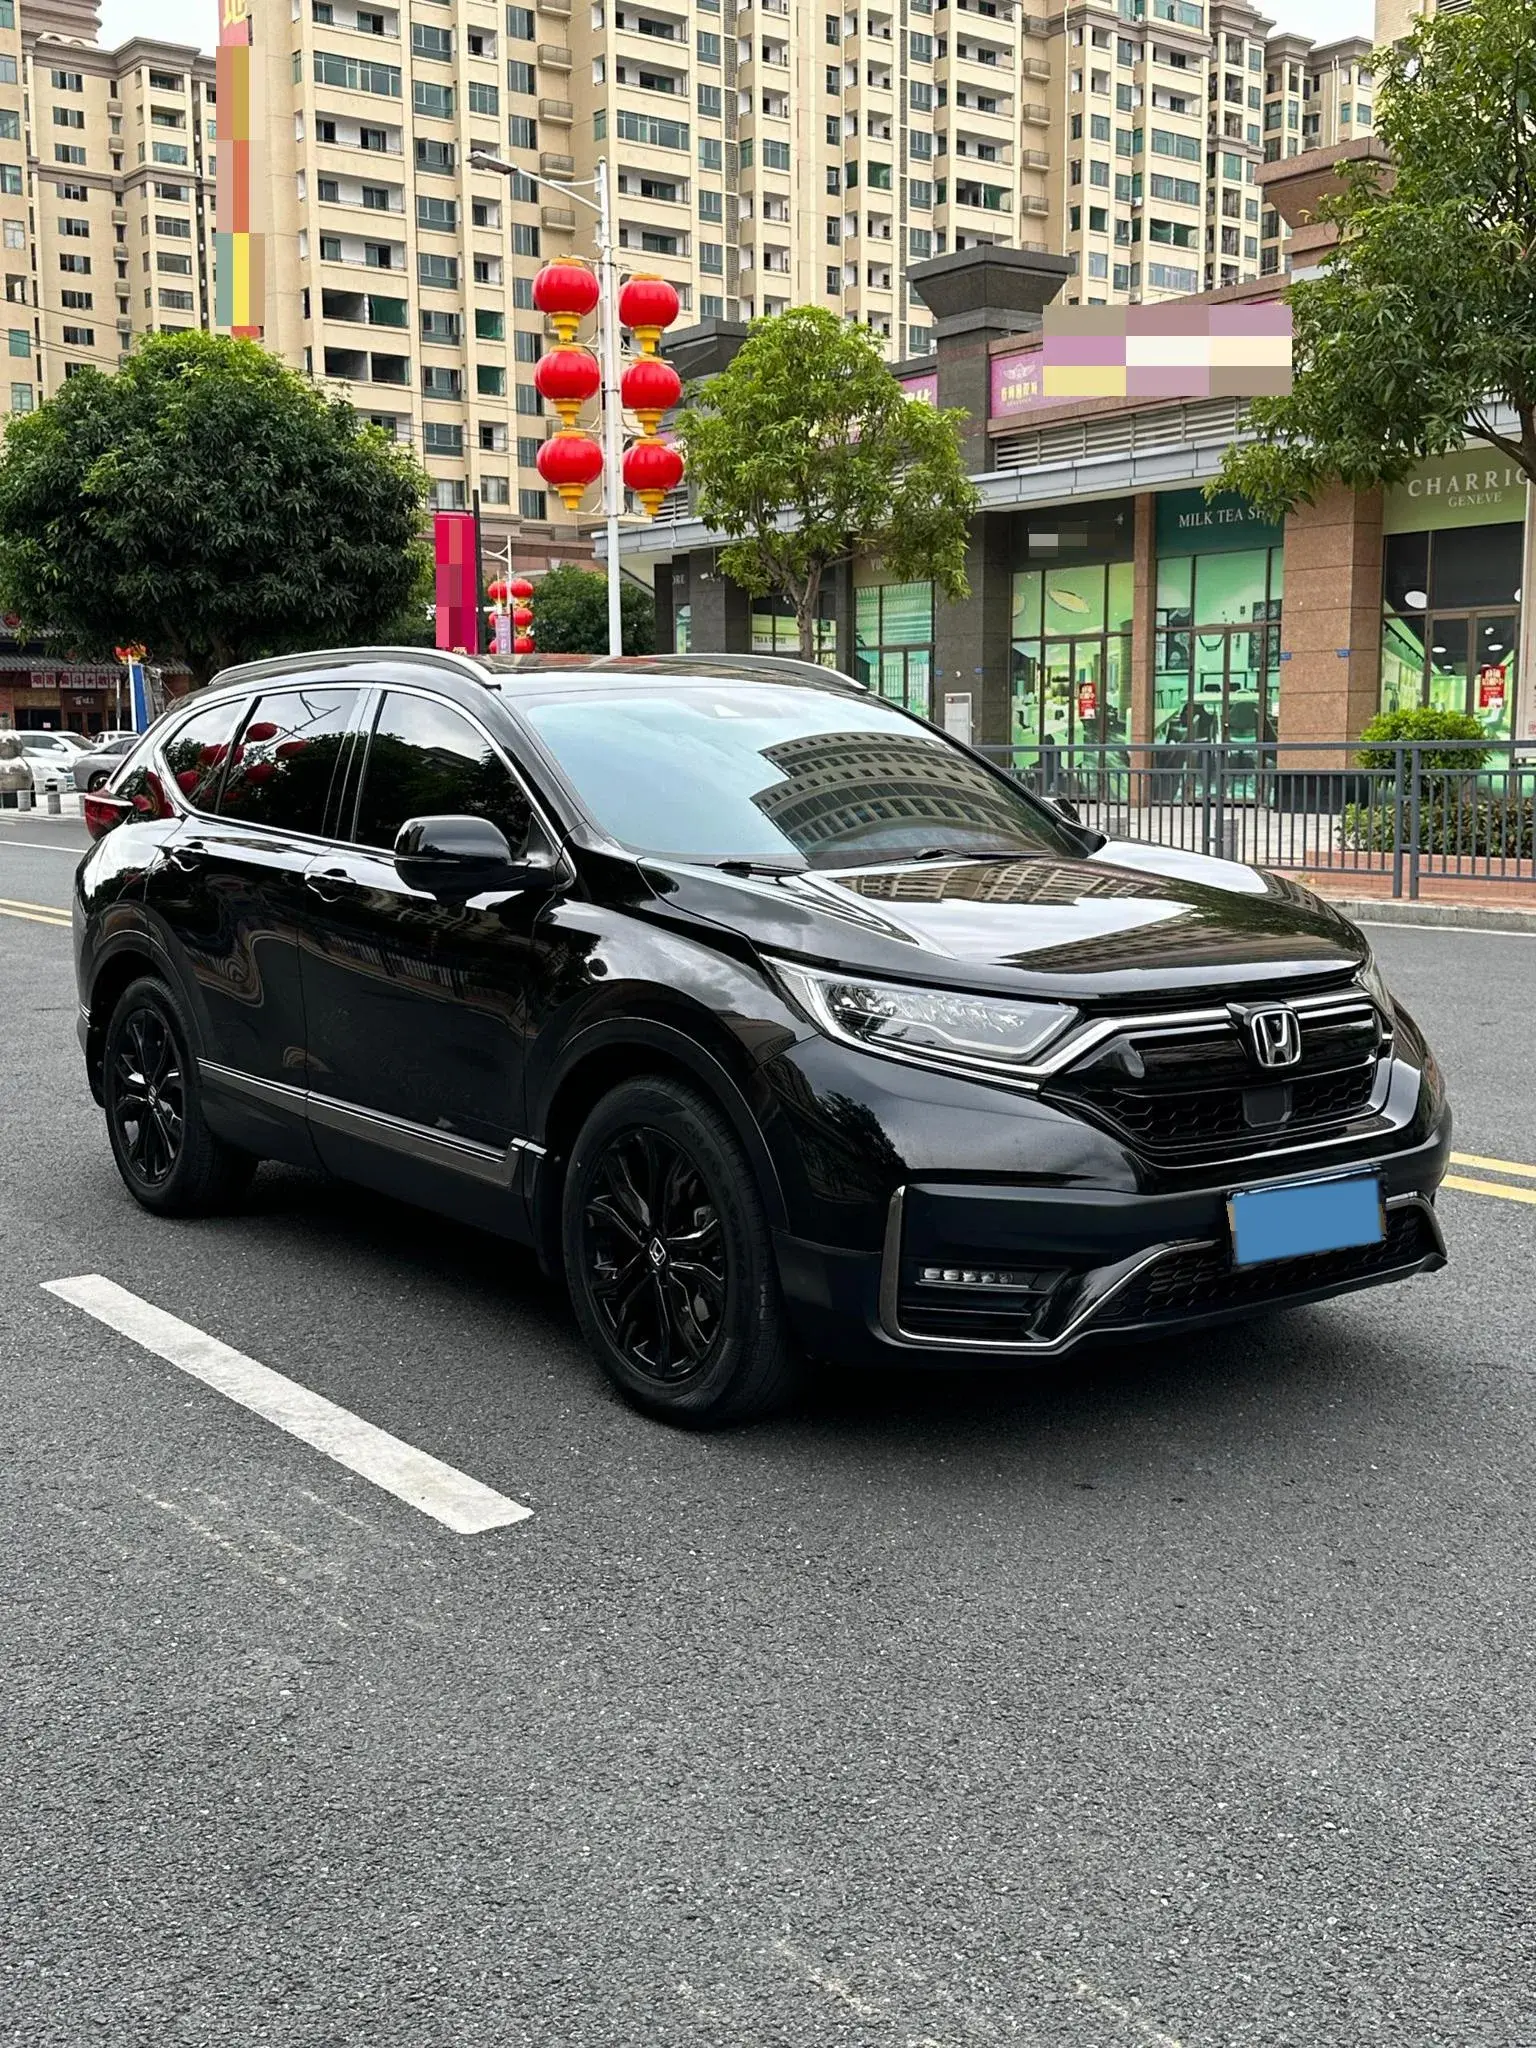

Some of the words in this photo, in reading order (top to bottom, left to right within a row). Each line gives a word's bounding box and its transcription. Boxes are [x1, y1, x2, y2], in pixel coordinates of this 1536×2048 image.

[1448, 491, 1502, 508] GENEVE
[1178, 511, 1213, 528] MILK
[1217, 508, 1243, 523] TEA
